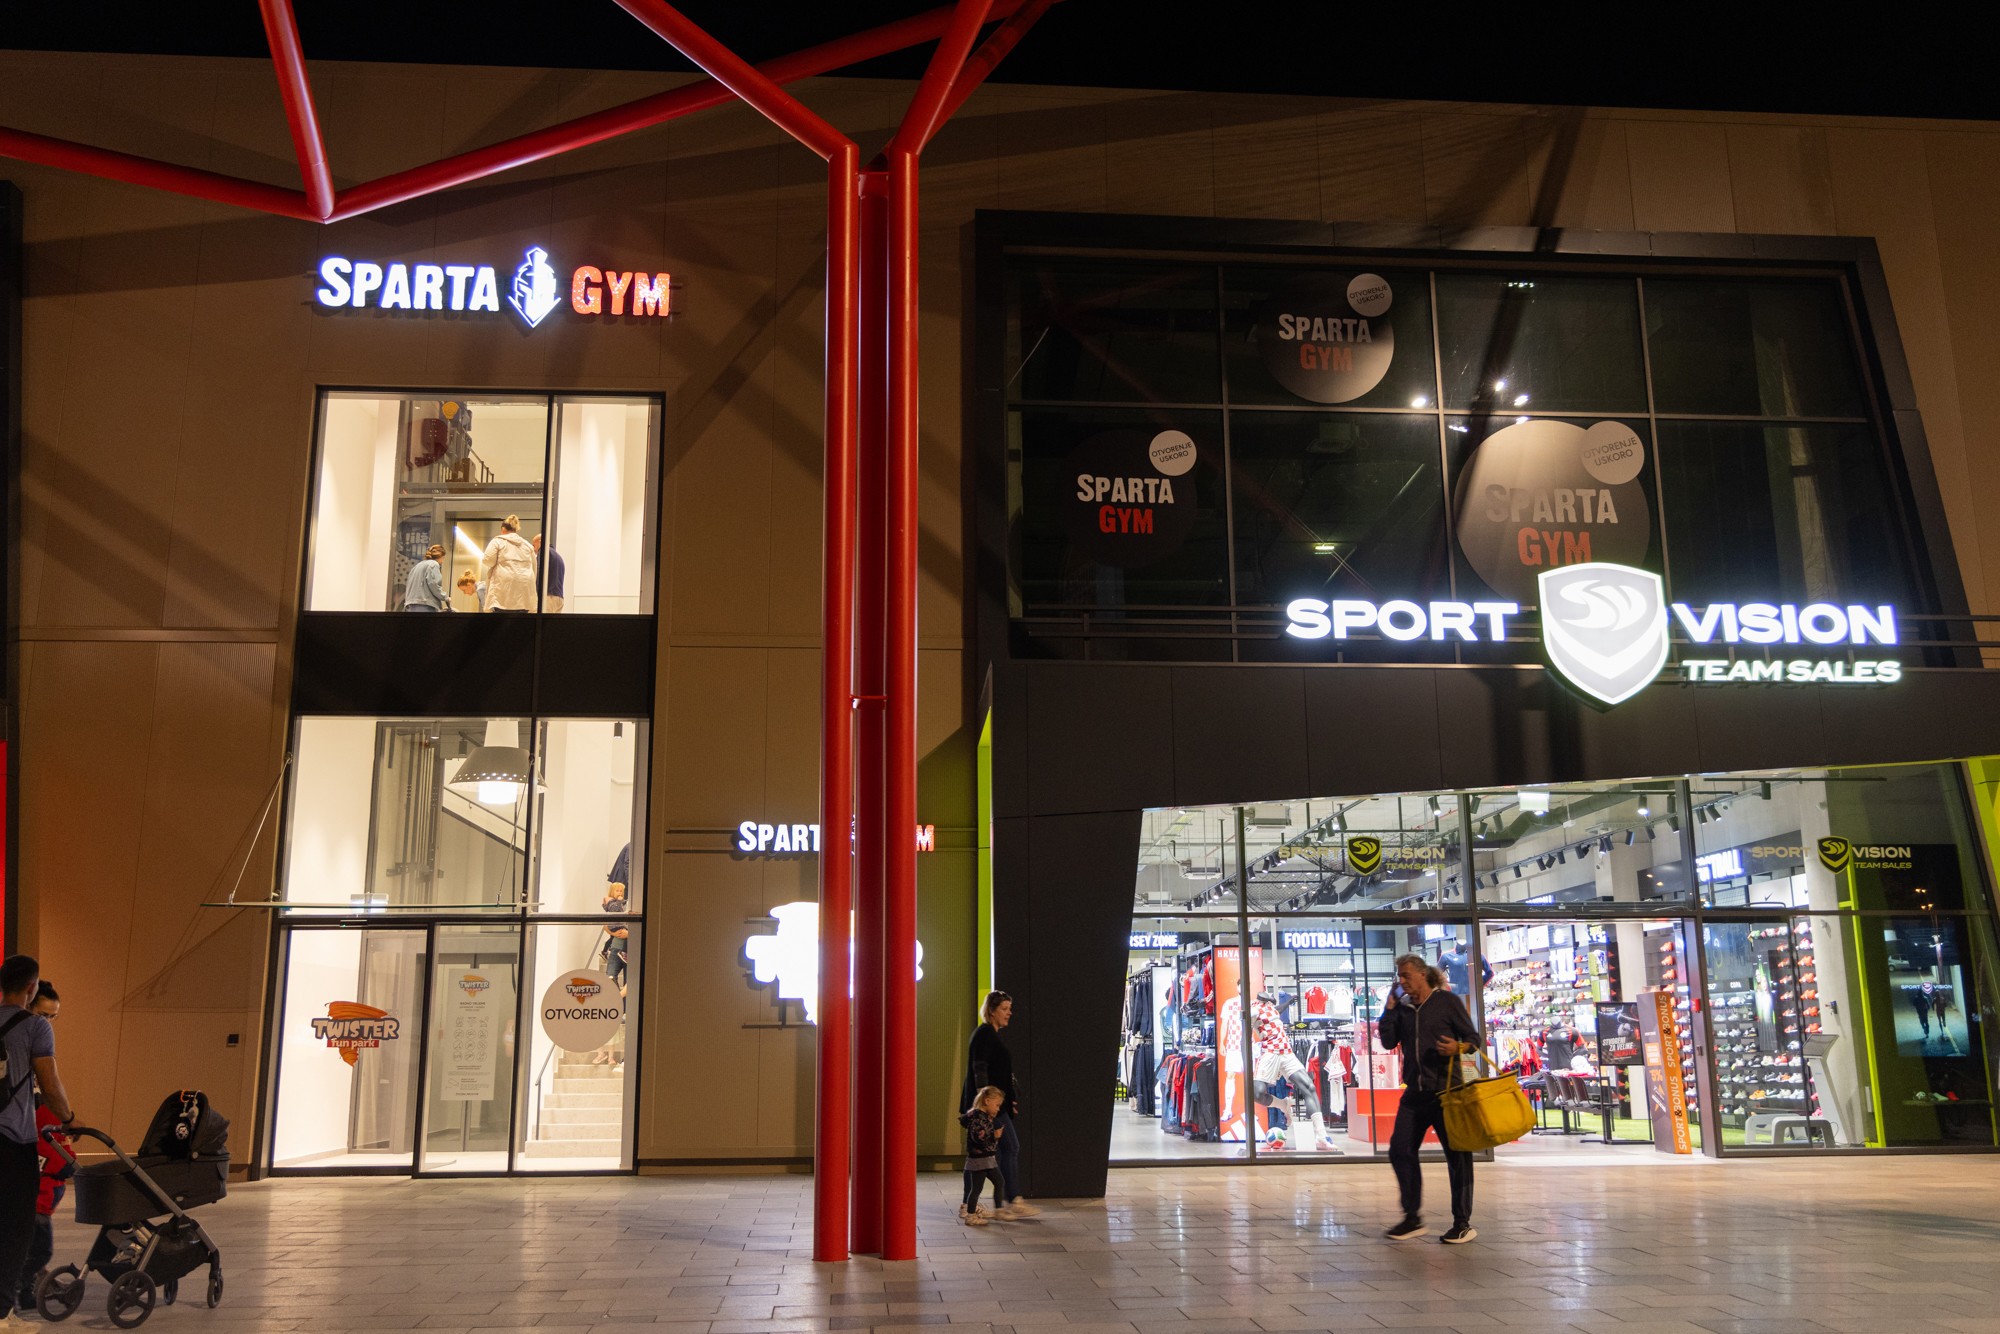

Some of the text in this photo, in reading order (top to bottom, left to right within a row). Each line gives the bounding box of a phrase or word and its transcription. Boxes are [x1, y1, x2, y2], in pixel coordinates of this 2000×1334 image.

[317, 257, 671, 317] SPARTA GYM
[1350, 284, 1388, 299] OTVORENJE
[1356, 292, 1385, 305] USKORO
[1278, 313, 1372, 343] SPARTA
[1300, 343, 1353, 371] GYM
[1151, 441, 1193, 458] OTVORENJE
[1159, 450, 1189, 463] USKORO
[1584, 436, 1638, 459] OTVORENJE
[1594, 448, 1634, 466] USKORO
[1077, 473, 1174, 504] SPARTA
[1485, 484, 1618, 524] SPARTA
[1099, 505, 1153, 534] GYM
[1517, 527, 1592, 566] GYM
[1285, 598, 1898, 646] SPORT VISION
[1682, 659, 1902, 684] TEAM SALES
[738, 821, 820, 852] SPART
[1278, 846, 1445, 859] SPORT VISION
[1752, 846, 1911, 858] SPORT VISION
[1385, 862, 1414, 870] TEAM
[1152, 935, 1178, 947] ZONE
[1284, 932, 1351, 948] FOOTBALL
[1217, 949, 1259, 958] HRVAKA
[460, 981, 489, 989] TWISTER
[566, 985, 600, 993] TWISTER
[545, 1008, 619, 1020] OTVORENO
[311, 1018, 399, 1040] TWISTER
[1658, 994, 1677, 1068] SPORT&BONUS
[331, 1039, 375, 1050] fun park
[1669, 1076, 1688, 1151] SPORT&BONUS
